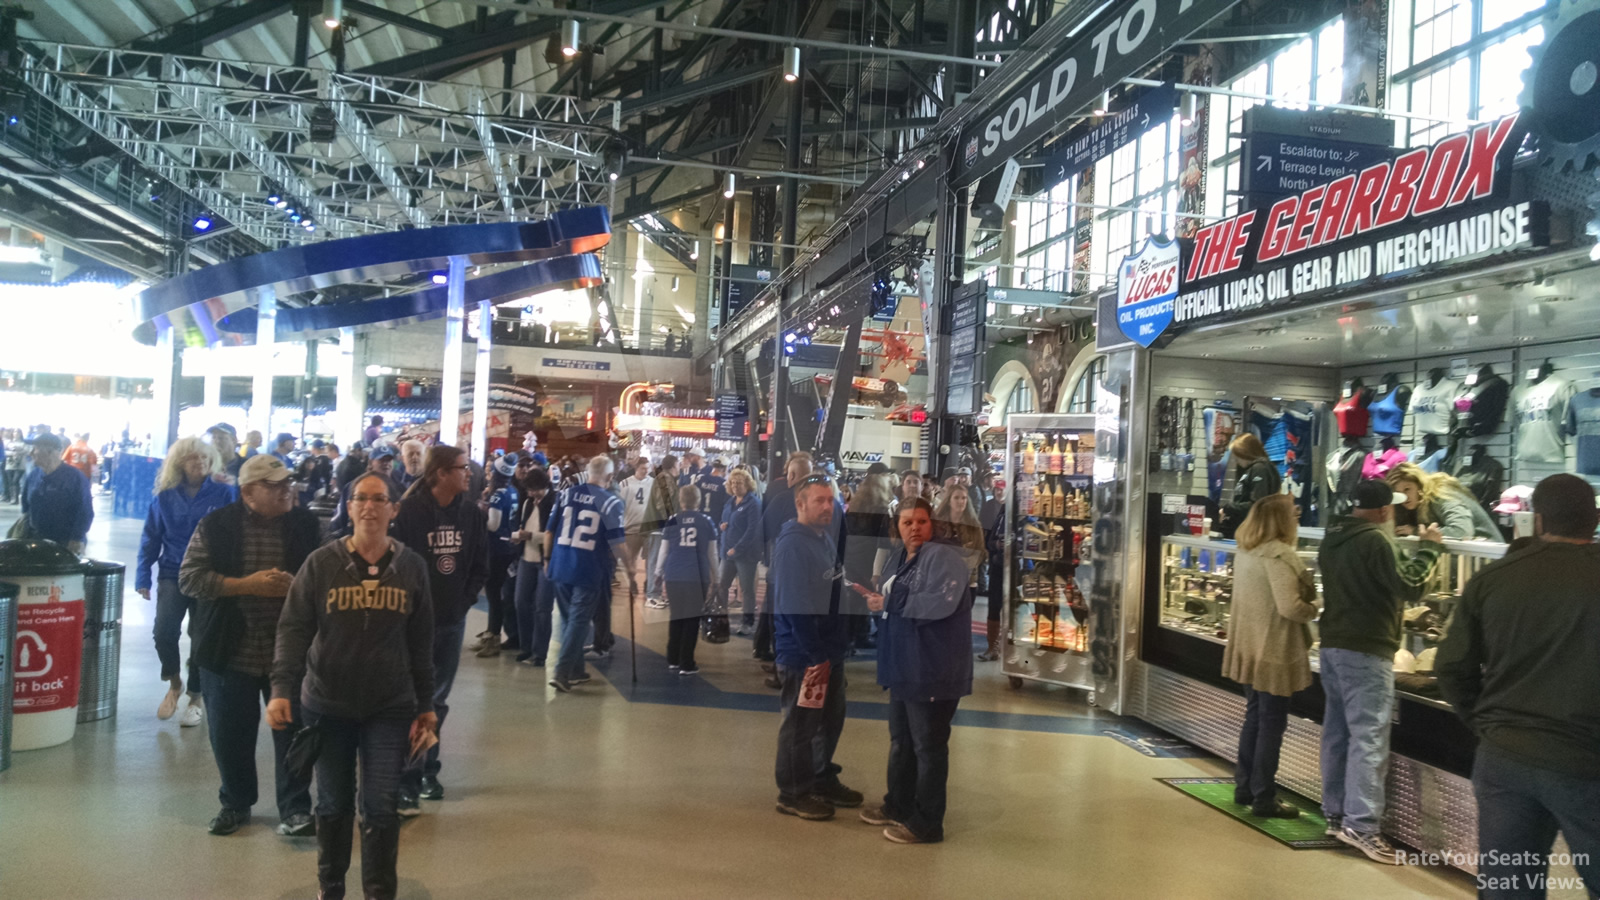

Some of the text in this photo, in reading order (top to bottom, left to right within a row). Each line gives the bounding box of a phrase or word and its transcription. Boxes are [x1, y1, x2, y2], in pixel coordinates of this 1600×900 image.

[1380, 16, 1388, 36] FUEL
[982, 0, 1156, 157] SOLD TO
[1075, 135, 1089, 154] RAMP
[1091, 129, 1099, 144] TO
[1101, 121, 1112, 139] ALL
[1115, 104, 1139, 130] LEVELS
[1309, 126, 1341, 135] STADIUM
[1279, 143, 1343, 161] Escalator to:
[1280, 160, 1345, 177] Terrace Level
[1279, 177, 1308, 190] North
[1185, 112, 1521, 283] THE GEARBOX
[1174, 201, 1531, 323] OFFICIAL LUCAS OIL GEAR AND MERCHANDISE
[1124, 265, 1176, 304] LUCAS
[1120, 299, 1174, 324] OIL PRODUCTS
[1139, 323, 1155, 336] INC.
[1042, 376, 1053, 403] 21
[573, 492, 596, 505] LUCK
[635, 487, 644, 505] 4
[703, 492, 711, 512] 1
[427, 530, 463, 547] CUBS
[557, 506, 600, 551] 12
[679, 527, 697, 547] 12
[326, 585, 409, 615] PURDUE
[32, 607, 66, 616] Recycle
[15, 678, 64, 692] it back
